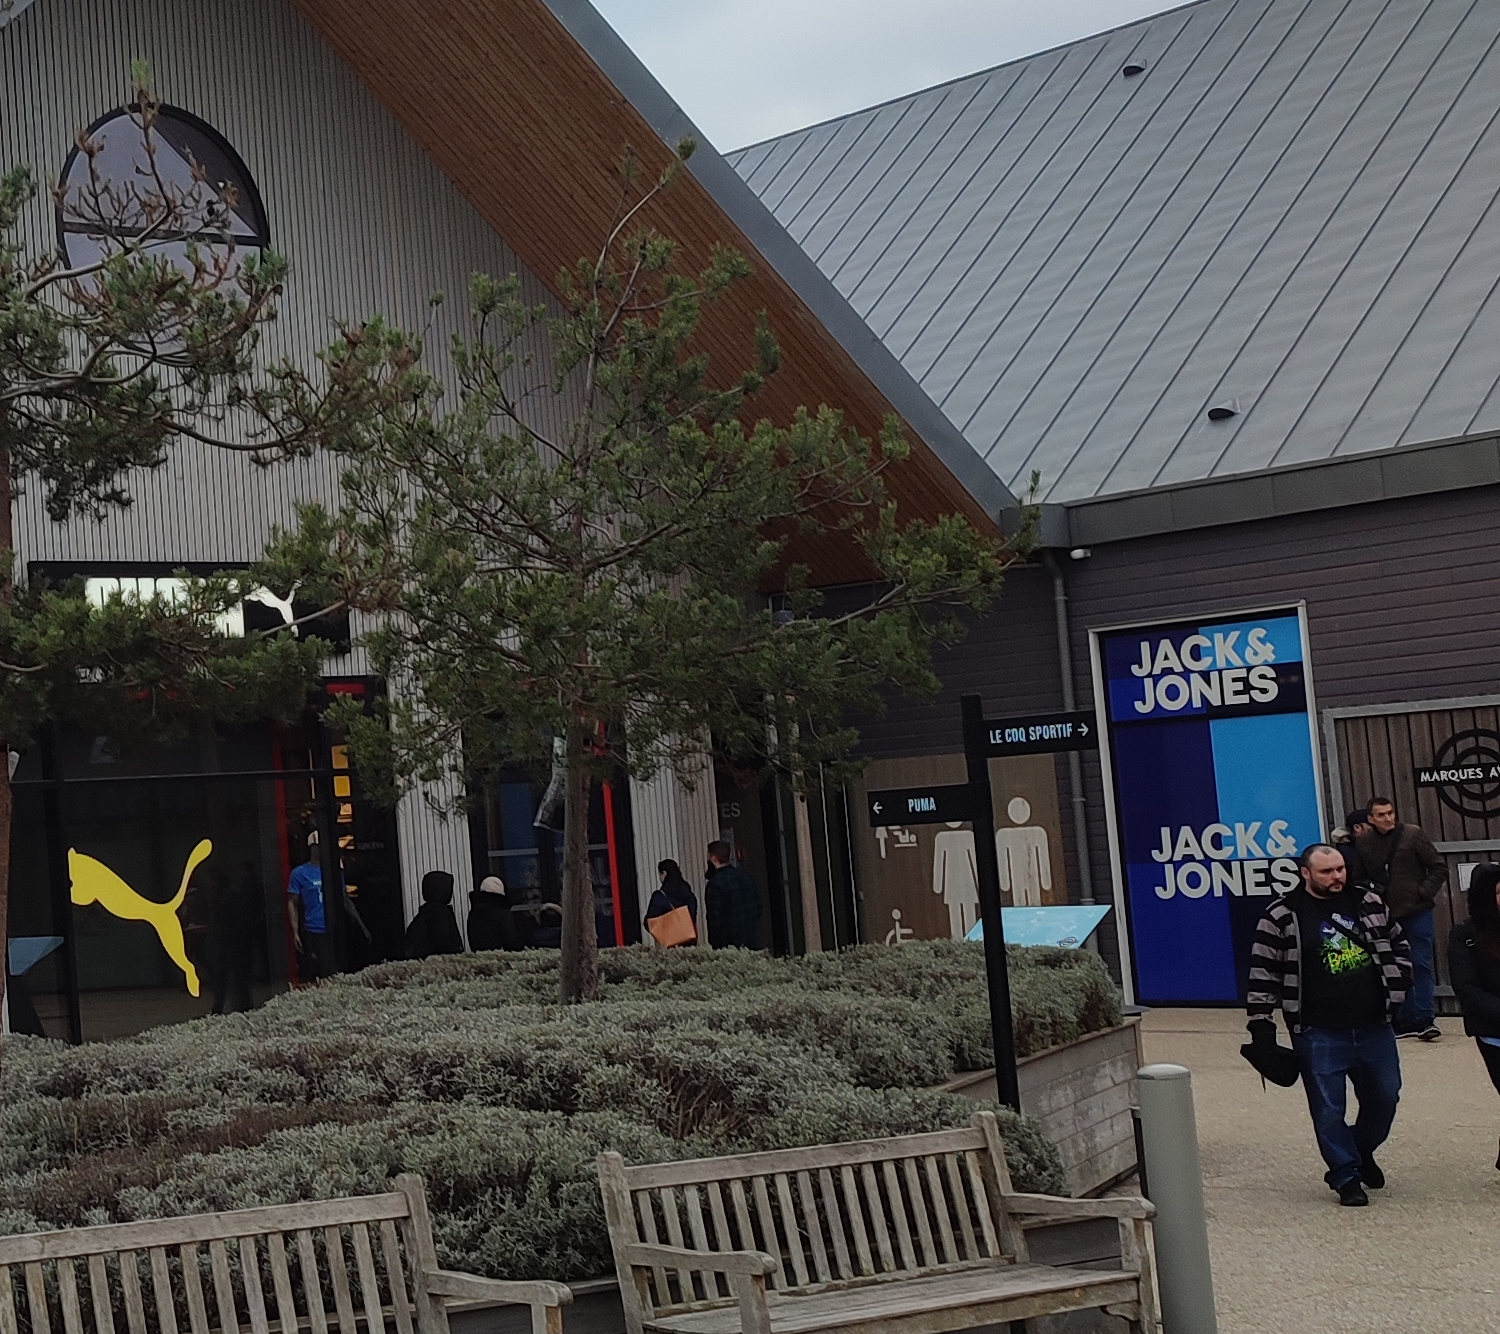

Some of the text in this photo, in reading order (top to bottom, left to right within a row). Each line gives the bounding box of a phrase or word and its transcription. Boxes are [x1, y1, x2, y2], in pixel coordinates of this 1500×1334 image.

[1130, 627, 1276, 677] JACK&
[1133, 665, 1279, 714] JONES
[989, 722, 1073, 744] LE COQ SPORTIF
[1420, 767, 1483, 784] MARQUES
[907, 796, 937, 813] PUMA
[1151, 819, 1298, 863] JACK&
[1154, 858, 1301, 900] JONES
